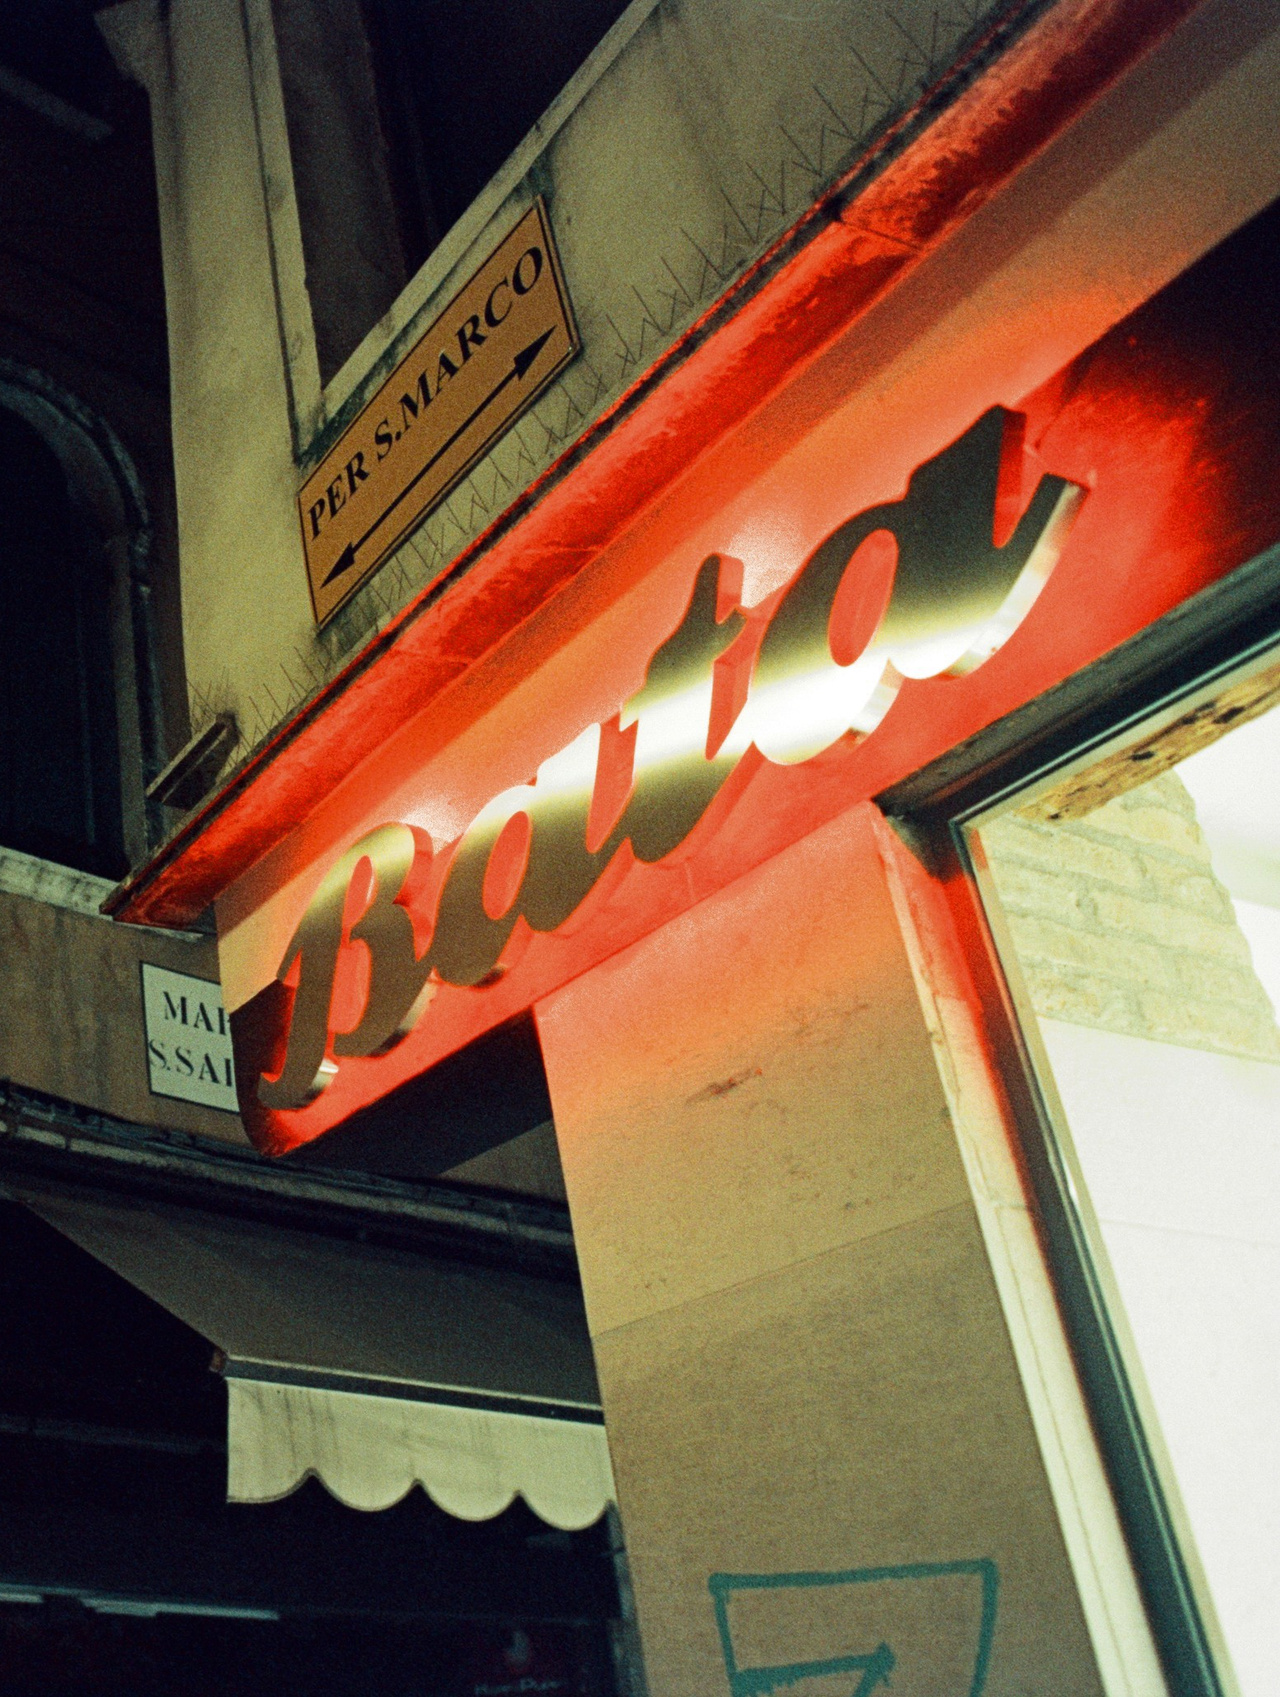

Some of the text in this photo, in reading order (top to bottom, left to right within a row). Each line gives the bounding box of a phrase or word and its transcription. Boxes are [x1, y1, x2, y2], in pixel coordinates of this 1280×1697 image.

[308, 245, 545, 542] PER S.MARCO
[256, 403, 1091, 1110] Bata
